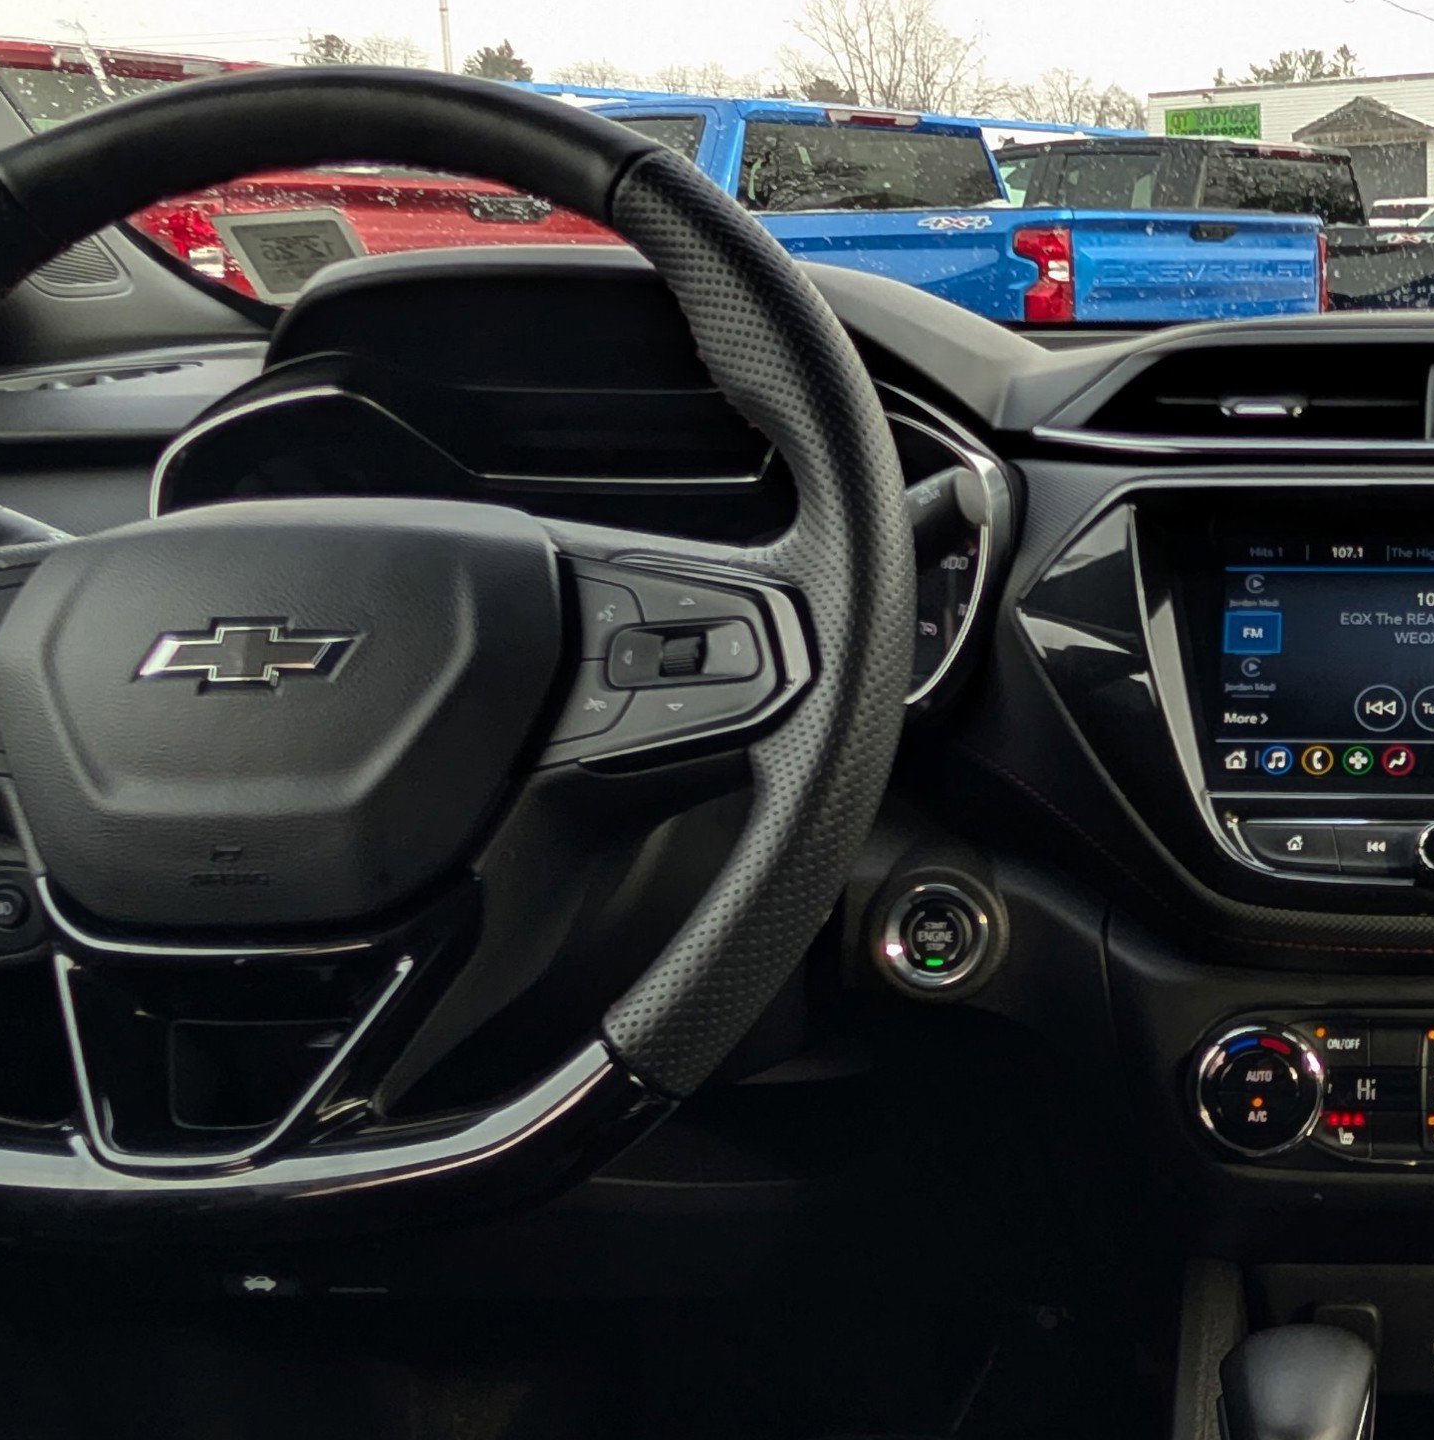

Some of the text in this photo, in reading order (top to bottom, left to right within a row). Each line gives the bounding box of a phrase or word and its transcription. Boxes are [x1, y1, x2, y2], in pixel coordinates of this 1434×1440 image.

[1249, 546, 1275, 559] Hits
[1331, 546, 1364, 559] 107.1
[1391, 547, 1413, 559] The
[1340, 613, 1373, 627] EQX
[1374, 613, 1403, 626] The
[1242, 627, 1264, 639] FM
[1224, 713, 1258, 725] More
[916, 930, 954, 942] ENGINE
[1326, 1038, 1361, 1051] ON/OFF
[1245, 1070, 1274, 1082] AUTO
[1356, 1078, 1377, 1101] Hi
[1247, 1110, 1269, 1122] A/C
